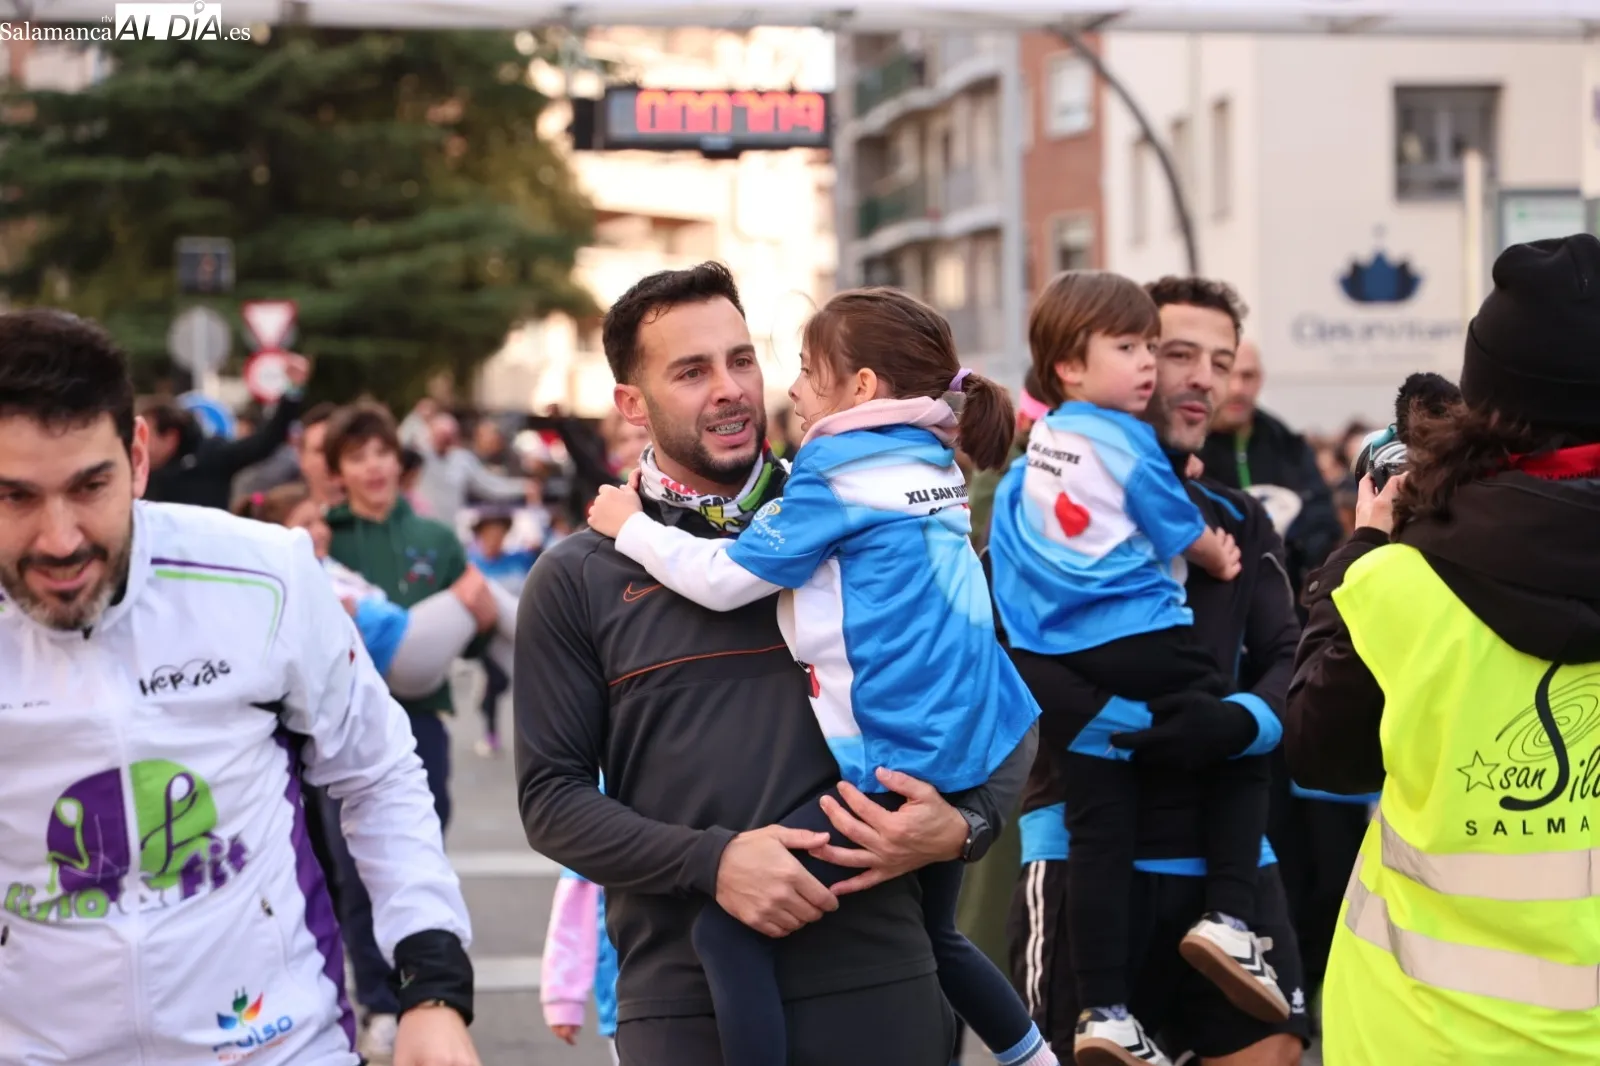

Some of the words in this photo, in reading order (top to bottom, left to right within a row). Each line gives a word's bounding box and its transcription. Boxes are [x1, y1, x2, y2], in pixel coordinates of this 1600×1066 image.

[904, 488, 931, 505] XLI
[931, 486, 954, 501] SAN
[1499, 765, 1548, 791] san
